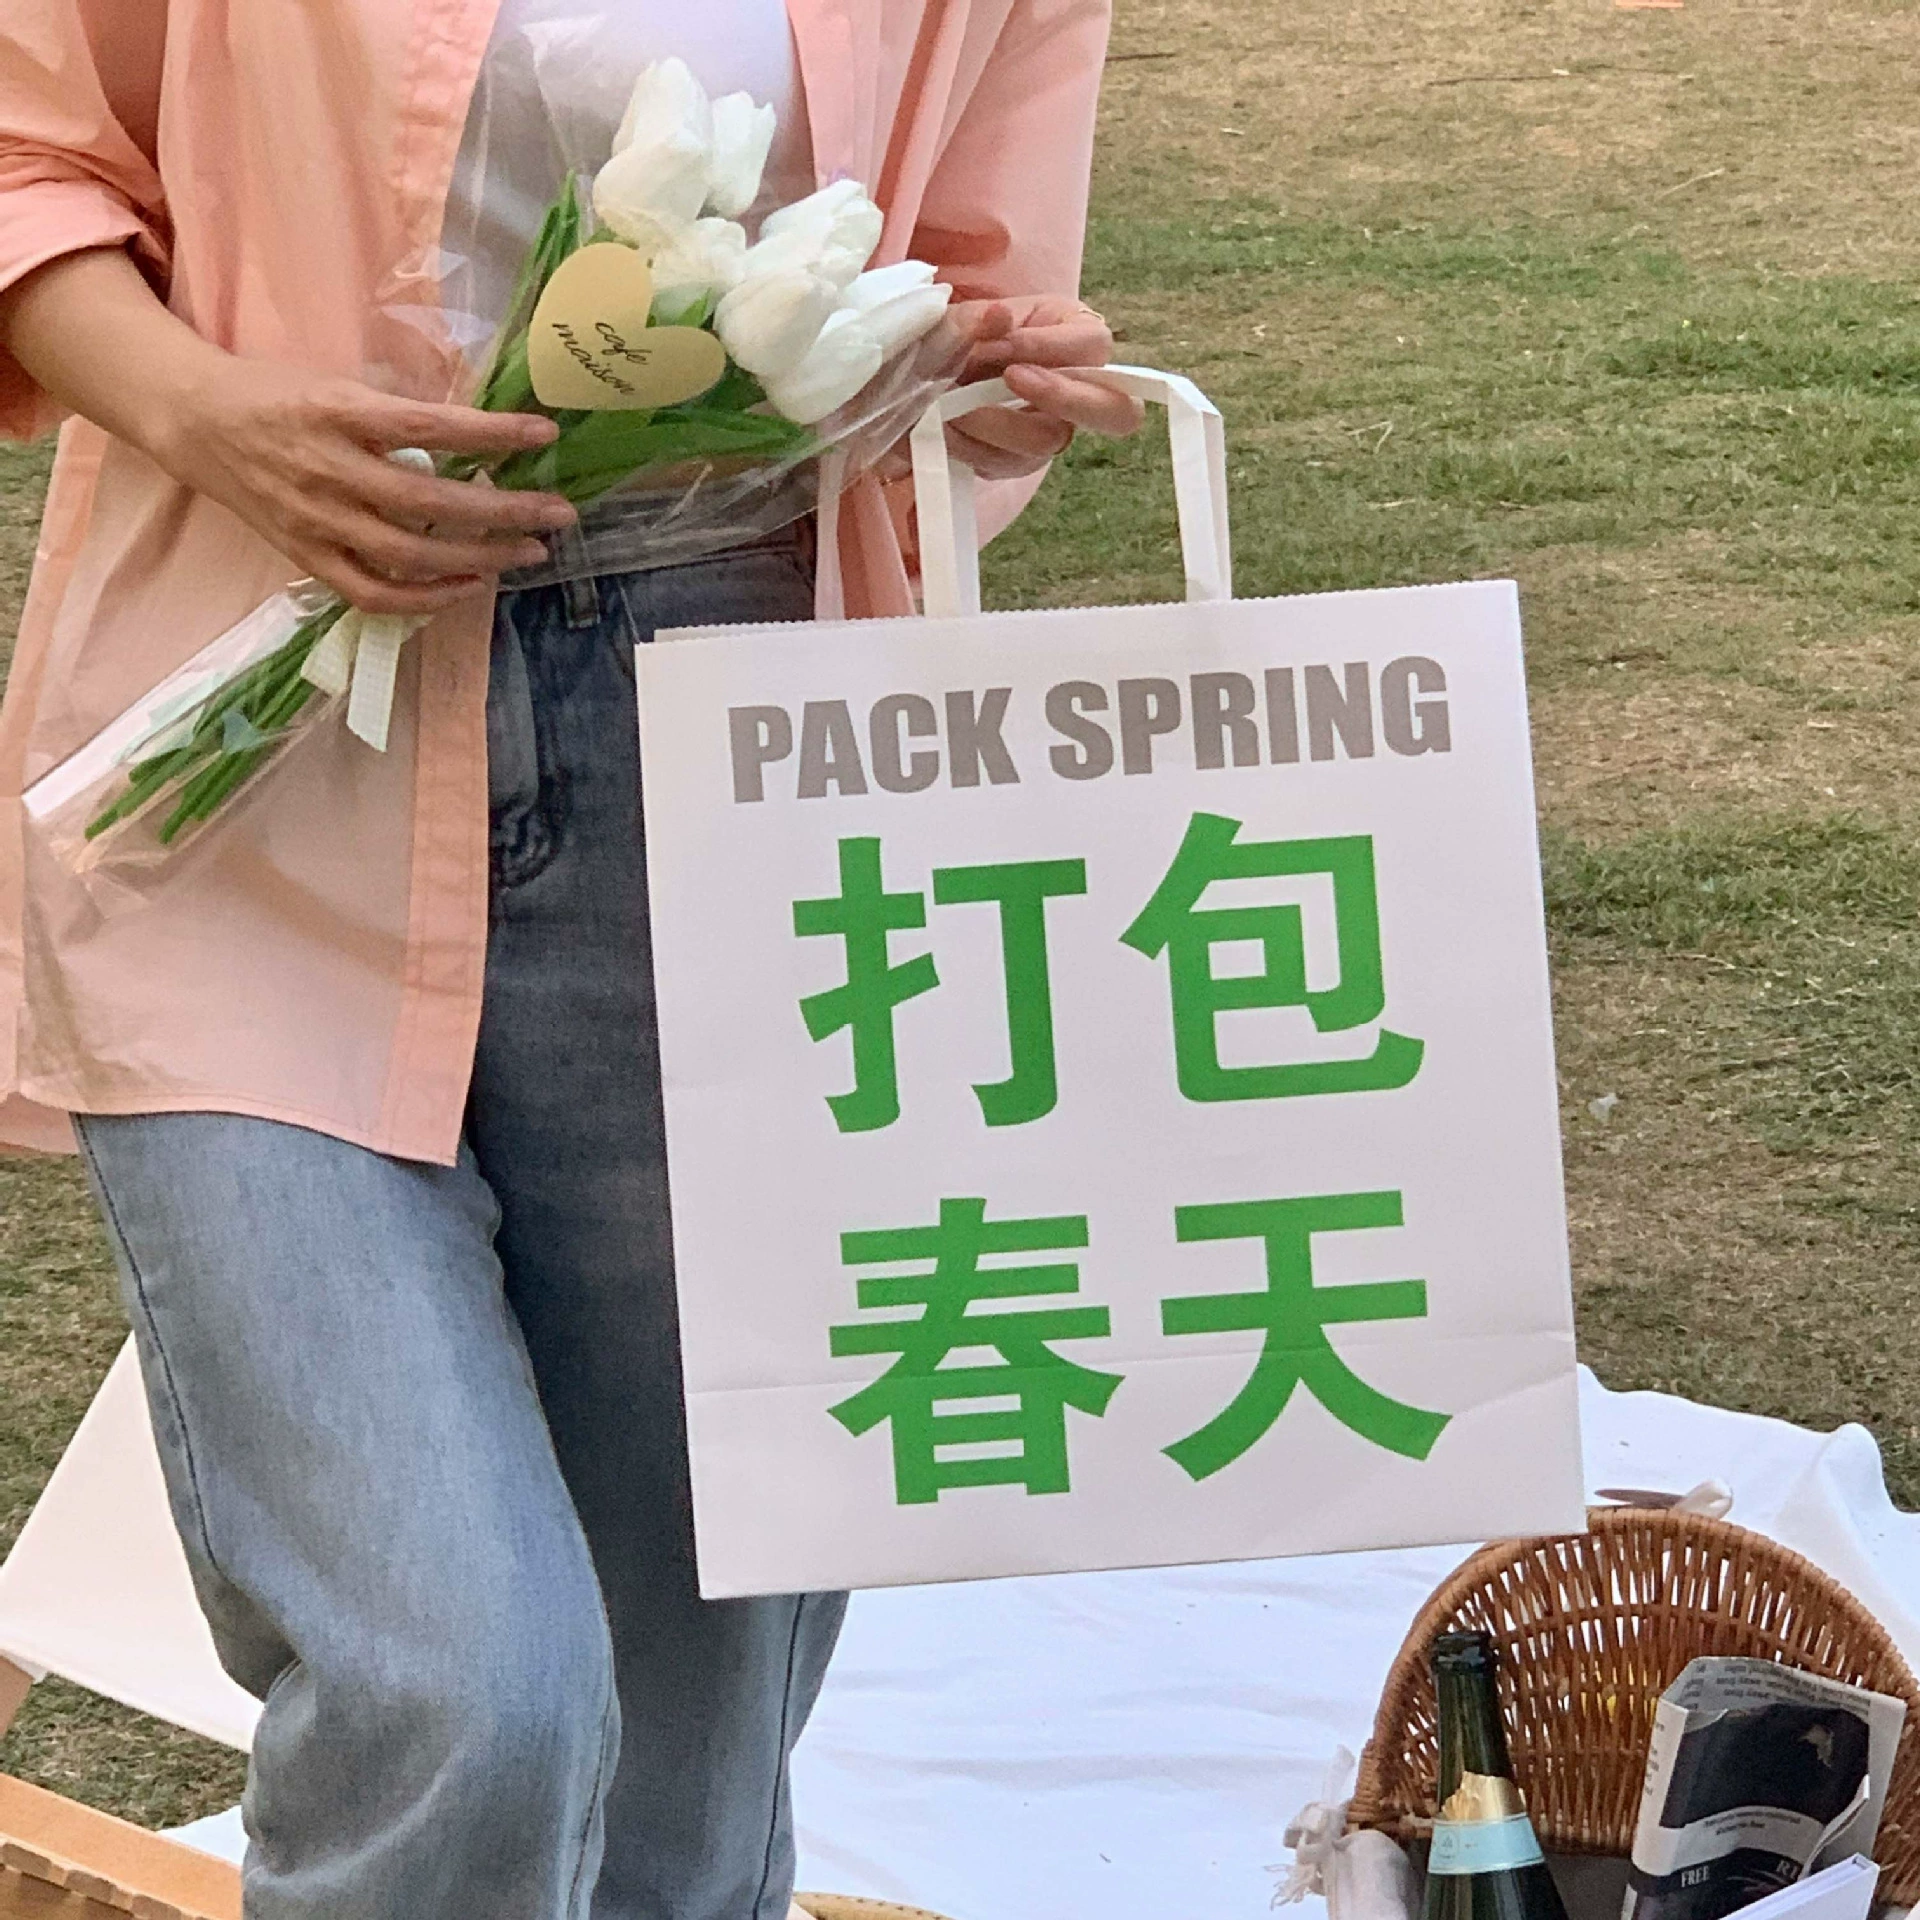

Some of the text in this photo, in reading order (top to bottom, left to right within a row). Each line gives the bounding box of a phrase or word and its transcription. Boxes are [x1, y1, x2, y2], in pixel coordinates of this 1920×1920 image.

[552, 323, 635, 394] maison
[729, 656, 1451, 803] PACK SPRING
[793, 812, 1424, 1133] 打包
[827, 1191, 1452, 1505] 春天
[1681, 1866, 1710, 1887] FREE
